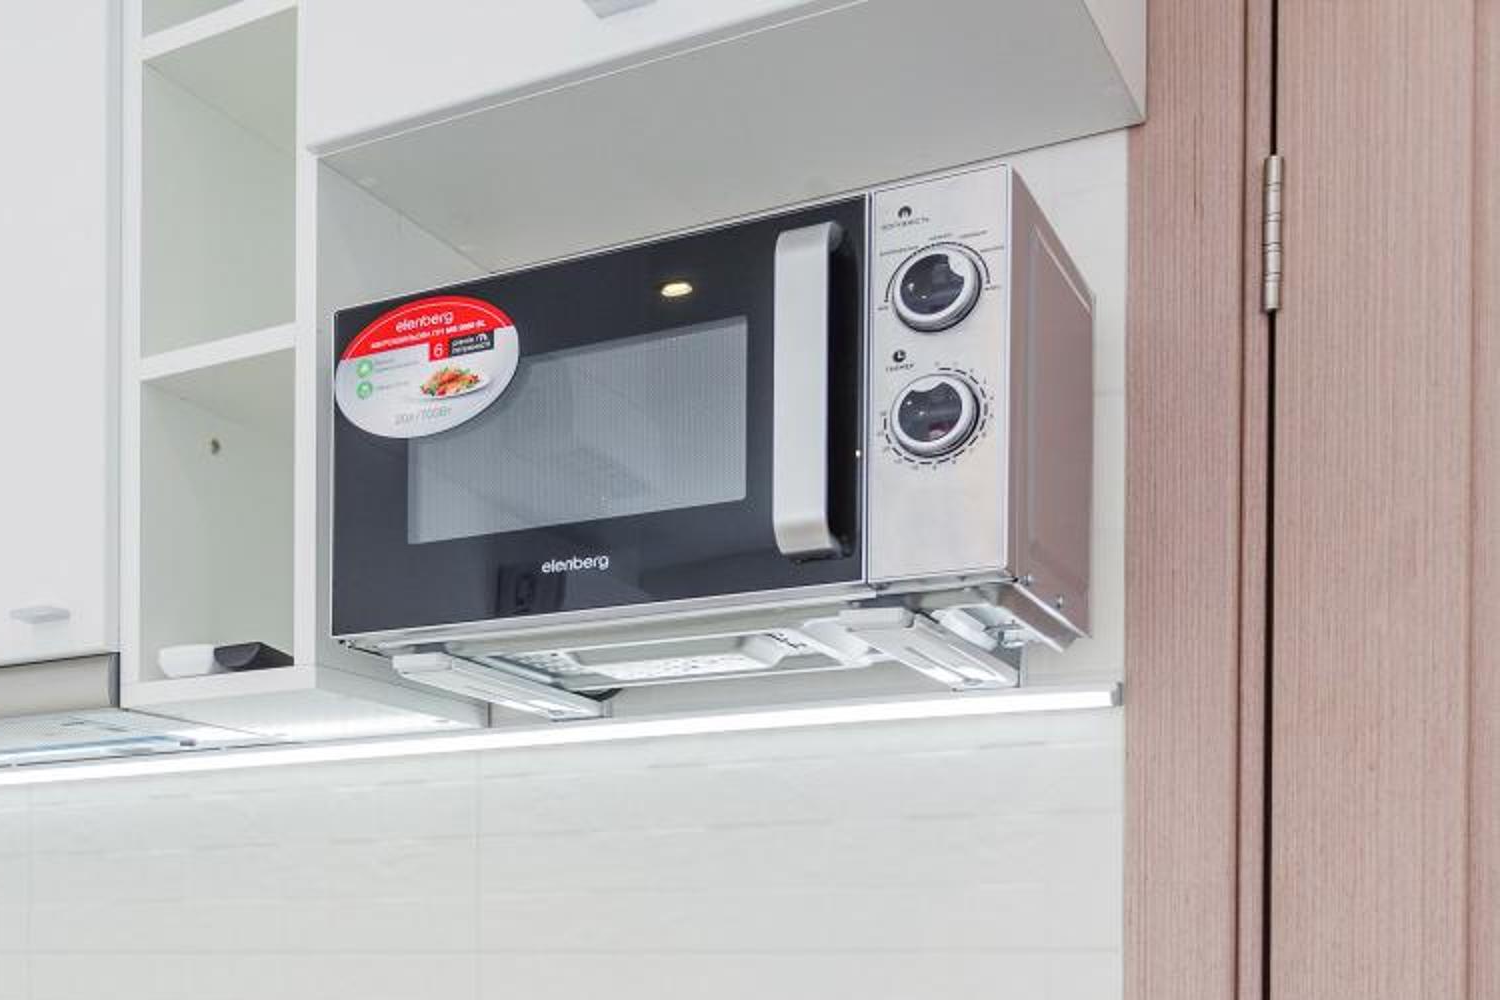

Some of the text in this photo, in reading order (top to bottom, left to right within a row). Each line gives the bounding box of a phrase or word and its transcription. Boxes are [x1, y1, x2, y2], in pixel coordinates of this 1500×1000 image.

[395, 311, 454, 333] elenberg
[433, 343, 443, 358] 6
[541, 555, 609, 574] elenberg
